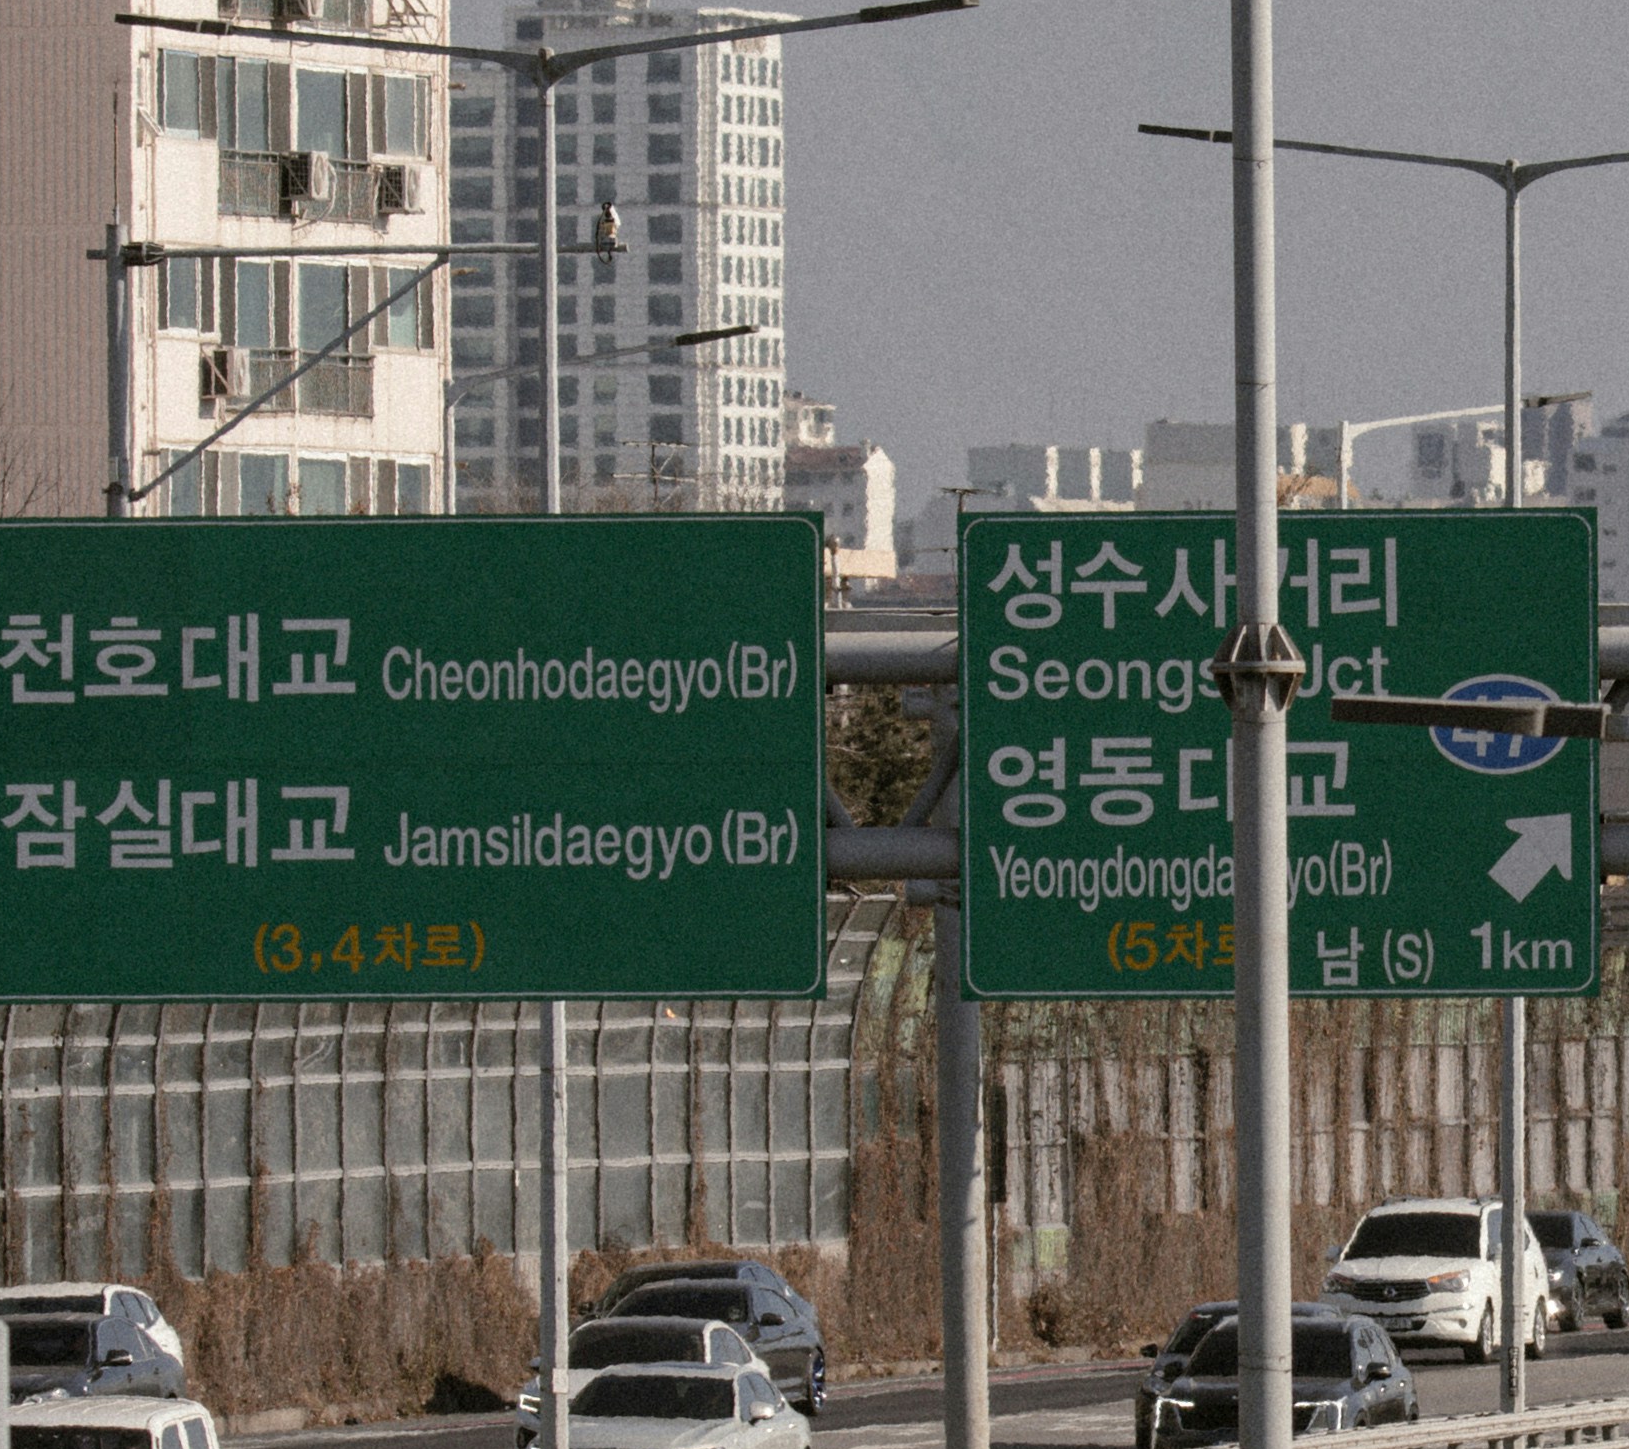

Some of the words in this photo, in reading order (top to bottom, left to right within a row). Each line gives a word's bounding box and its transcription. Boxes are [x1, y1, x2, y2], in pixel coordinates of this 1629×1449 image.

[382, 643, 798, 715] Cheonhodaegyo(Br)
[987, 645, 1215, 713] Seongs
[0, 777, 357, 869] 잠실대교
[989, 840, 1394, 912] Yeongdongdayo(Br)
[1317, 926, 1365, 987] 남
[1383, 927, 1434, 983] (S)
